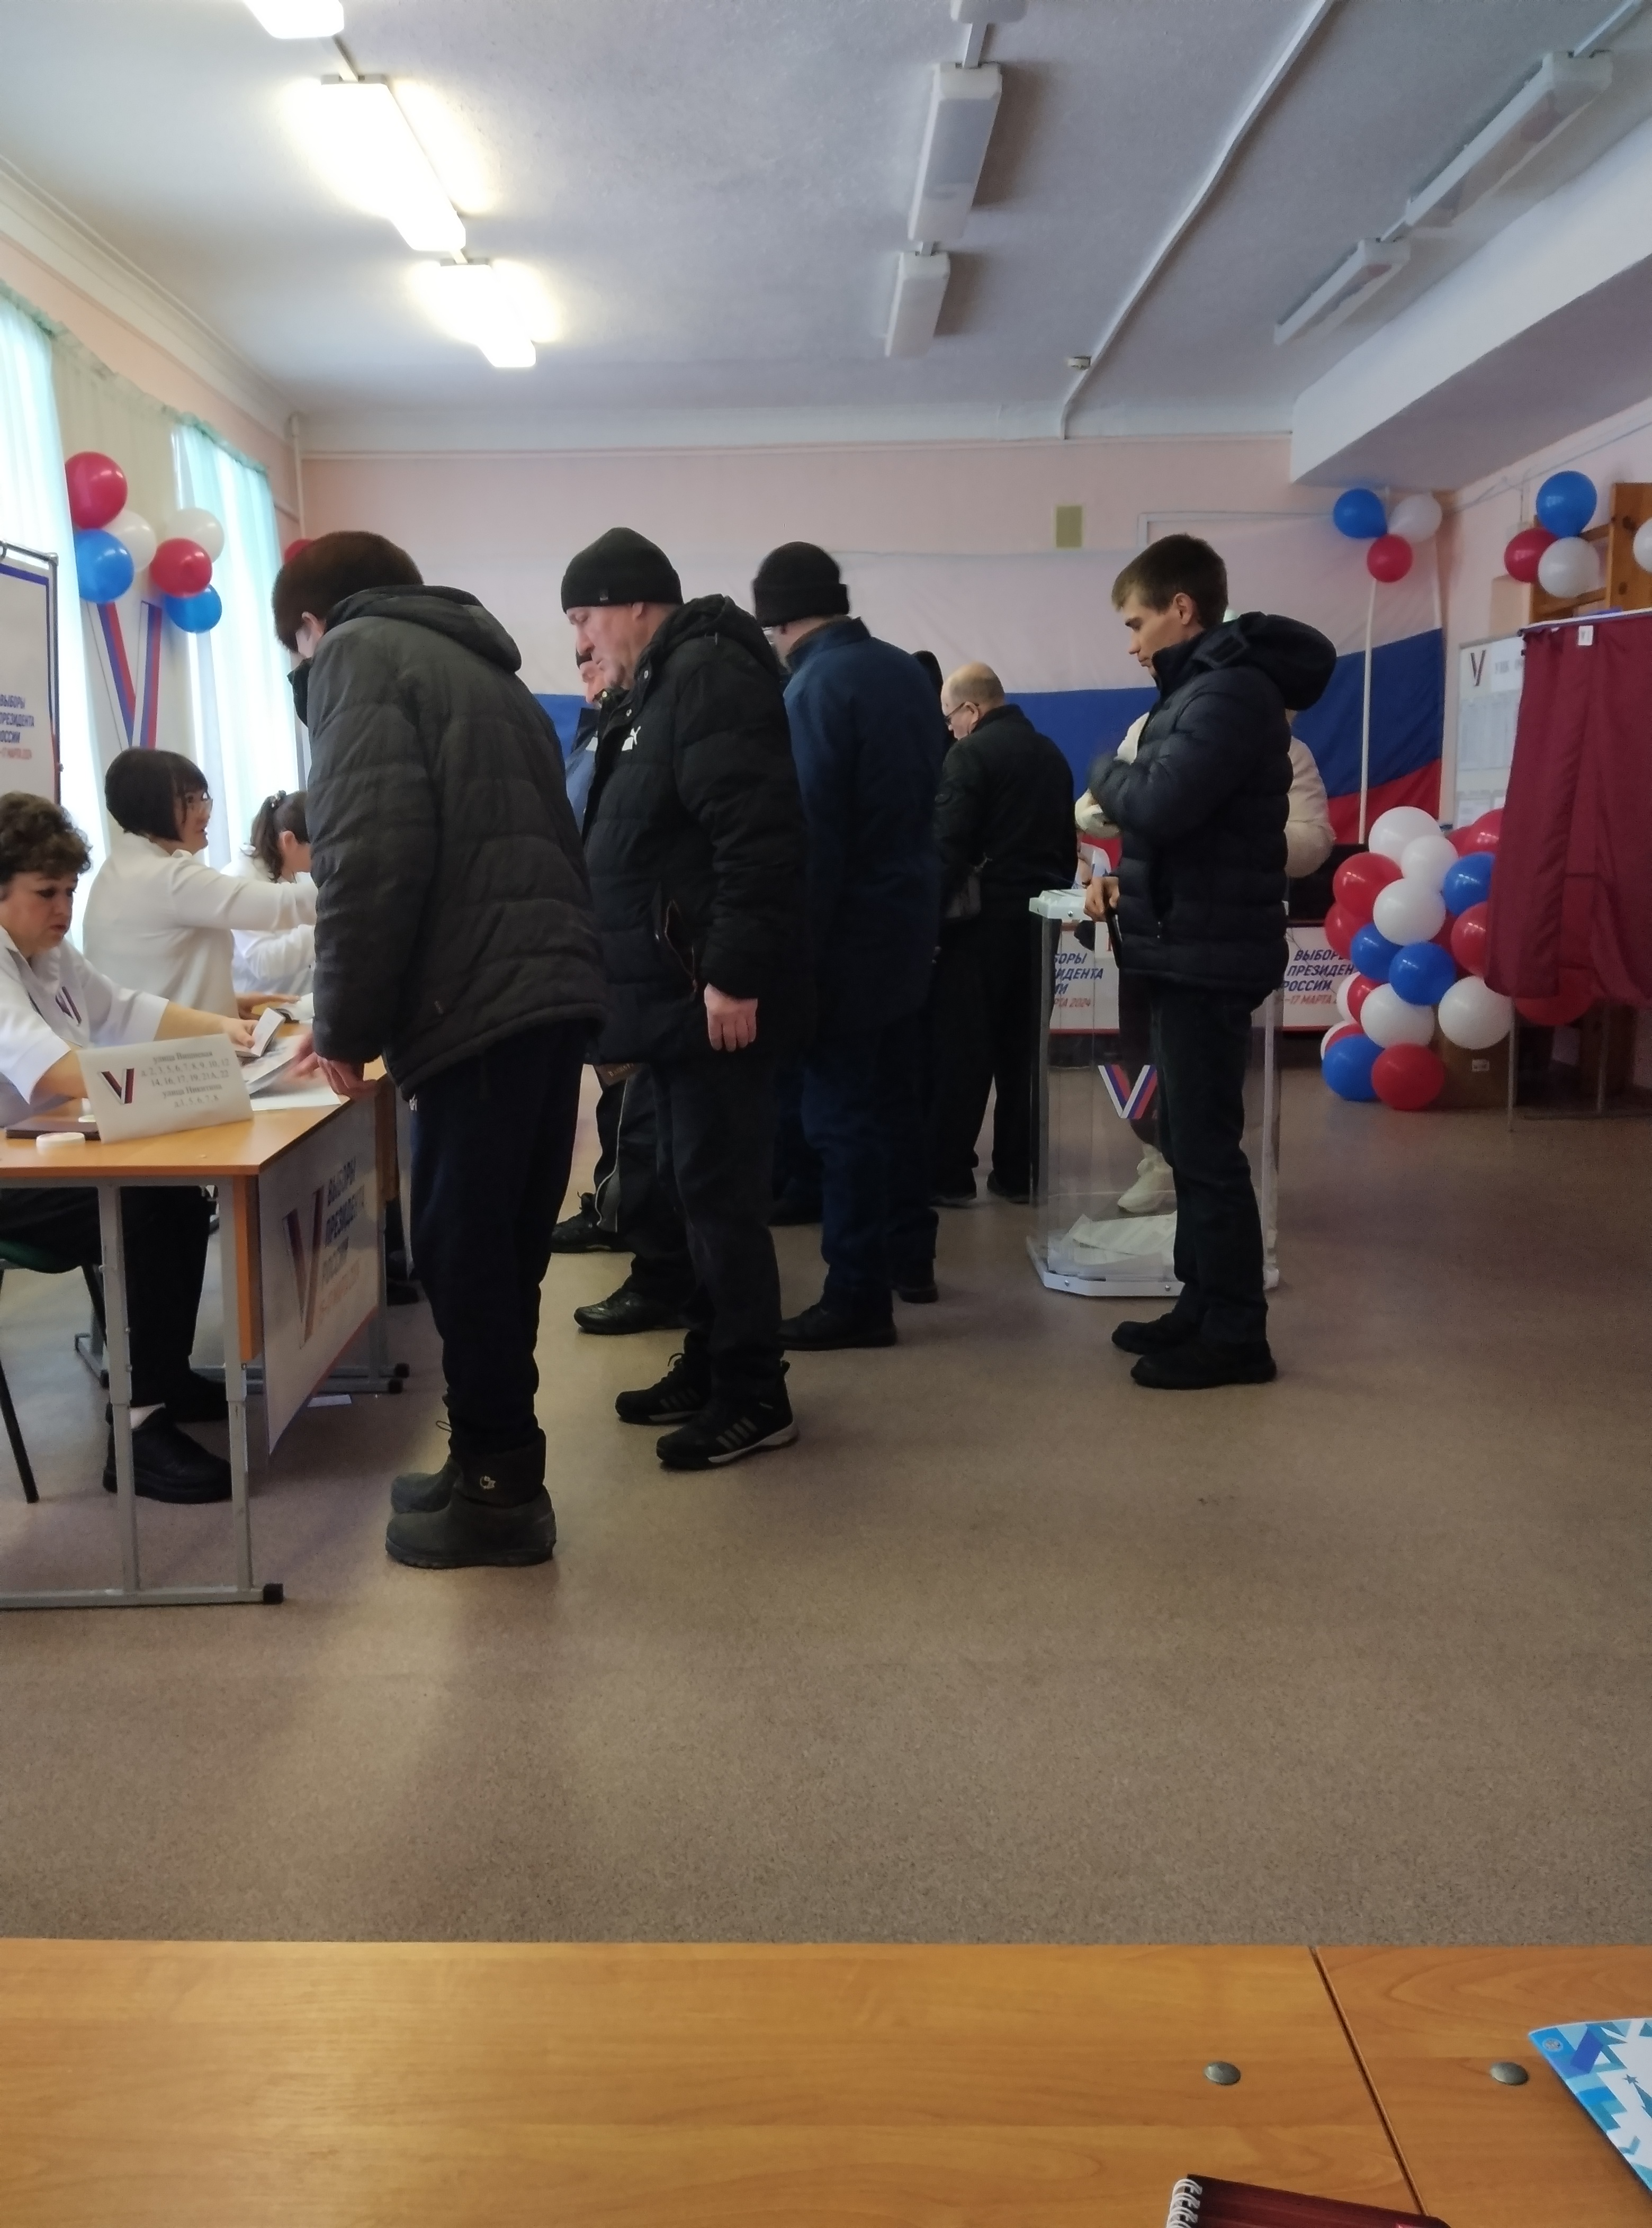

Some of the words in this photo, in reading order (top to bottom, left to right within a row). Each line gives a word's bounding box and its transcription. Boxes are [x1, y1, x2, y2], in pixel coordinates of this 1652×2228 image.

[1054, 953, 1088, 964] БОРЫ
[1293, 949, 1351, 961] ВЫБОР
[1287, 964, 1354, 977] ПРЕЗИДЕН
